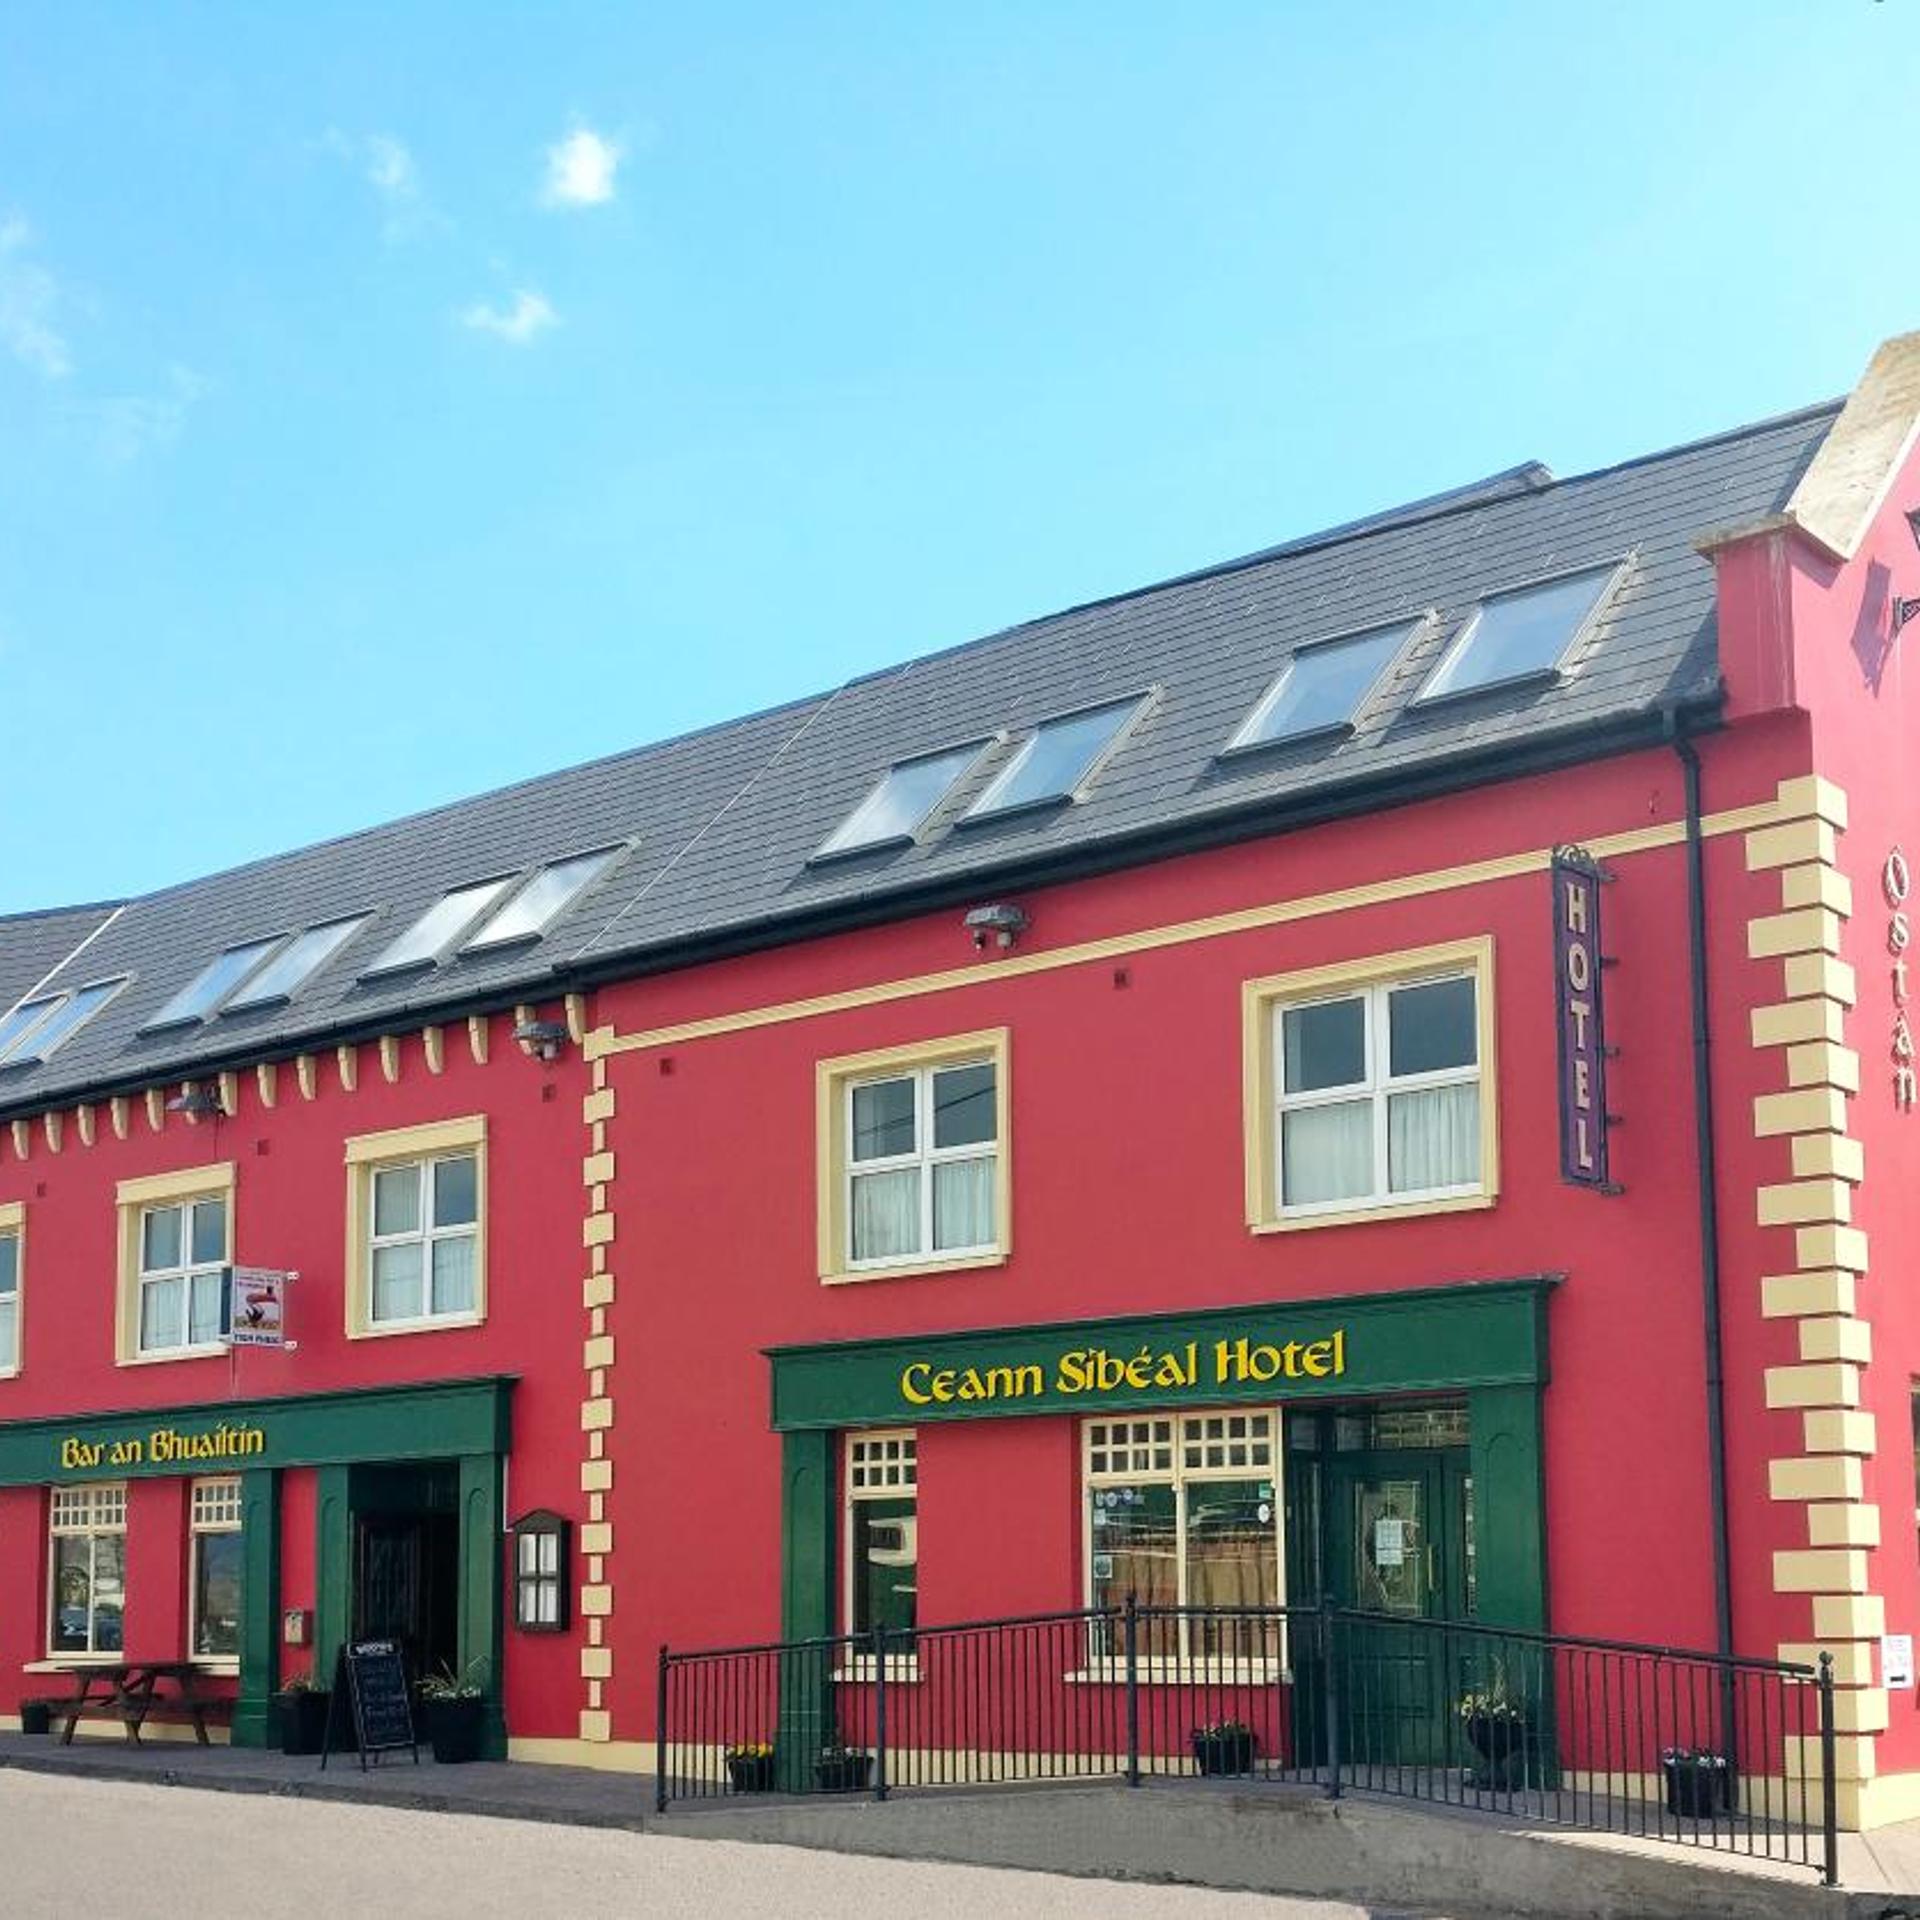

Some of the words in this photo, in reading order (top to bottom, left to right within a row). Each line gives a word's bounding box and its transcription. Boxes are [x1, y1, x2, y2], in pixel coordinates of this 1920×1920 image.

[1565, 881, 1593, 1170] HOTEL
[902, 1363, 1043, 1404] Ceann
[1216, 1330, 1346, 1383] Hotel
[61, 1437, 104, 1469] Bar
[110, 1440, 142, 1465] an
